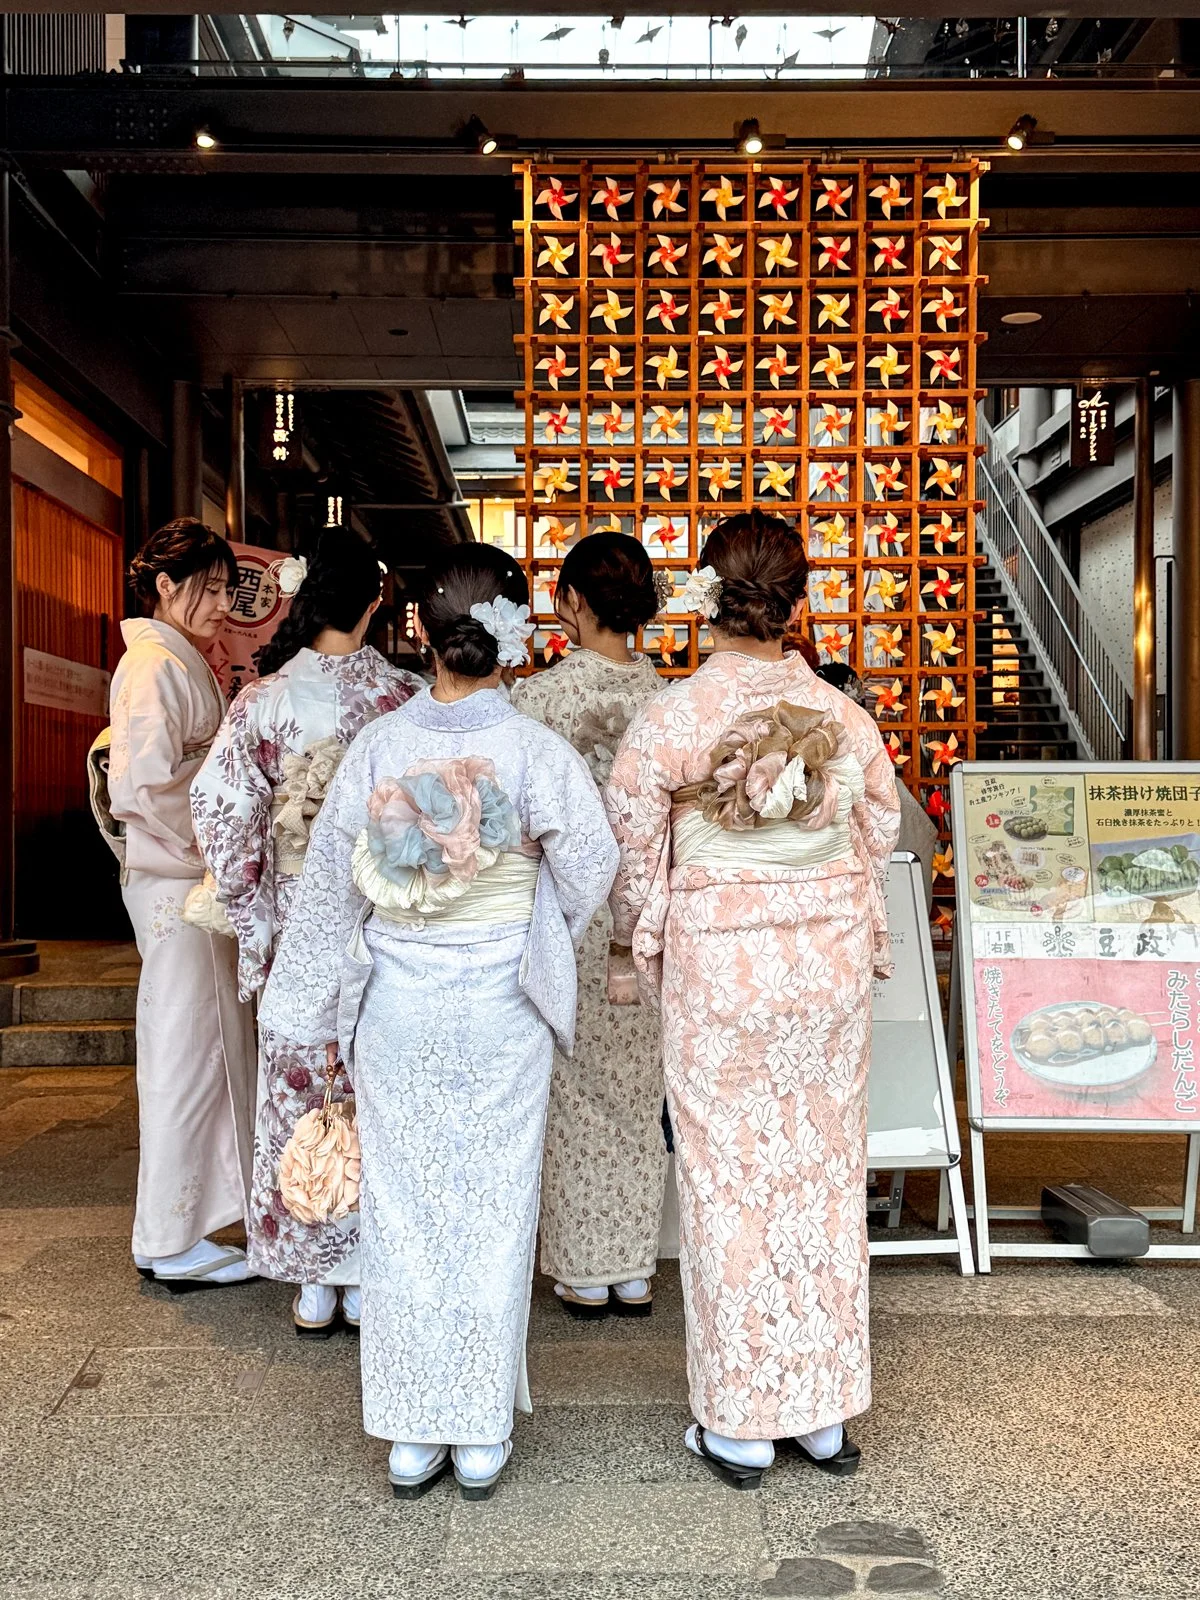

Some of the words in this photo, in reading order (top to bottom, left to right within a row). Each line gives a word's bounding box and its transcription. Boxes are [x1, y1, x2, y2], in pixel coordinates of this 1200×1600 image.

[1089, 785, 1200, 801] 抹茶掛け焼団子
[991, 942, 1015, 954] 右奥
[984, 967, 1007, 1108] 焼きたてをどうぞ
[1167, 970, 1195, 1113] みたらしだんご
